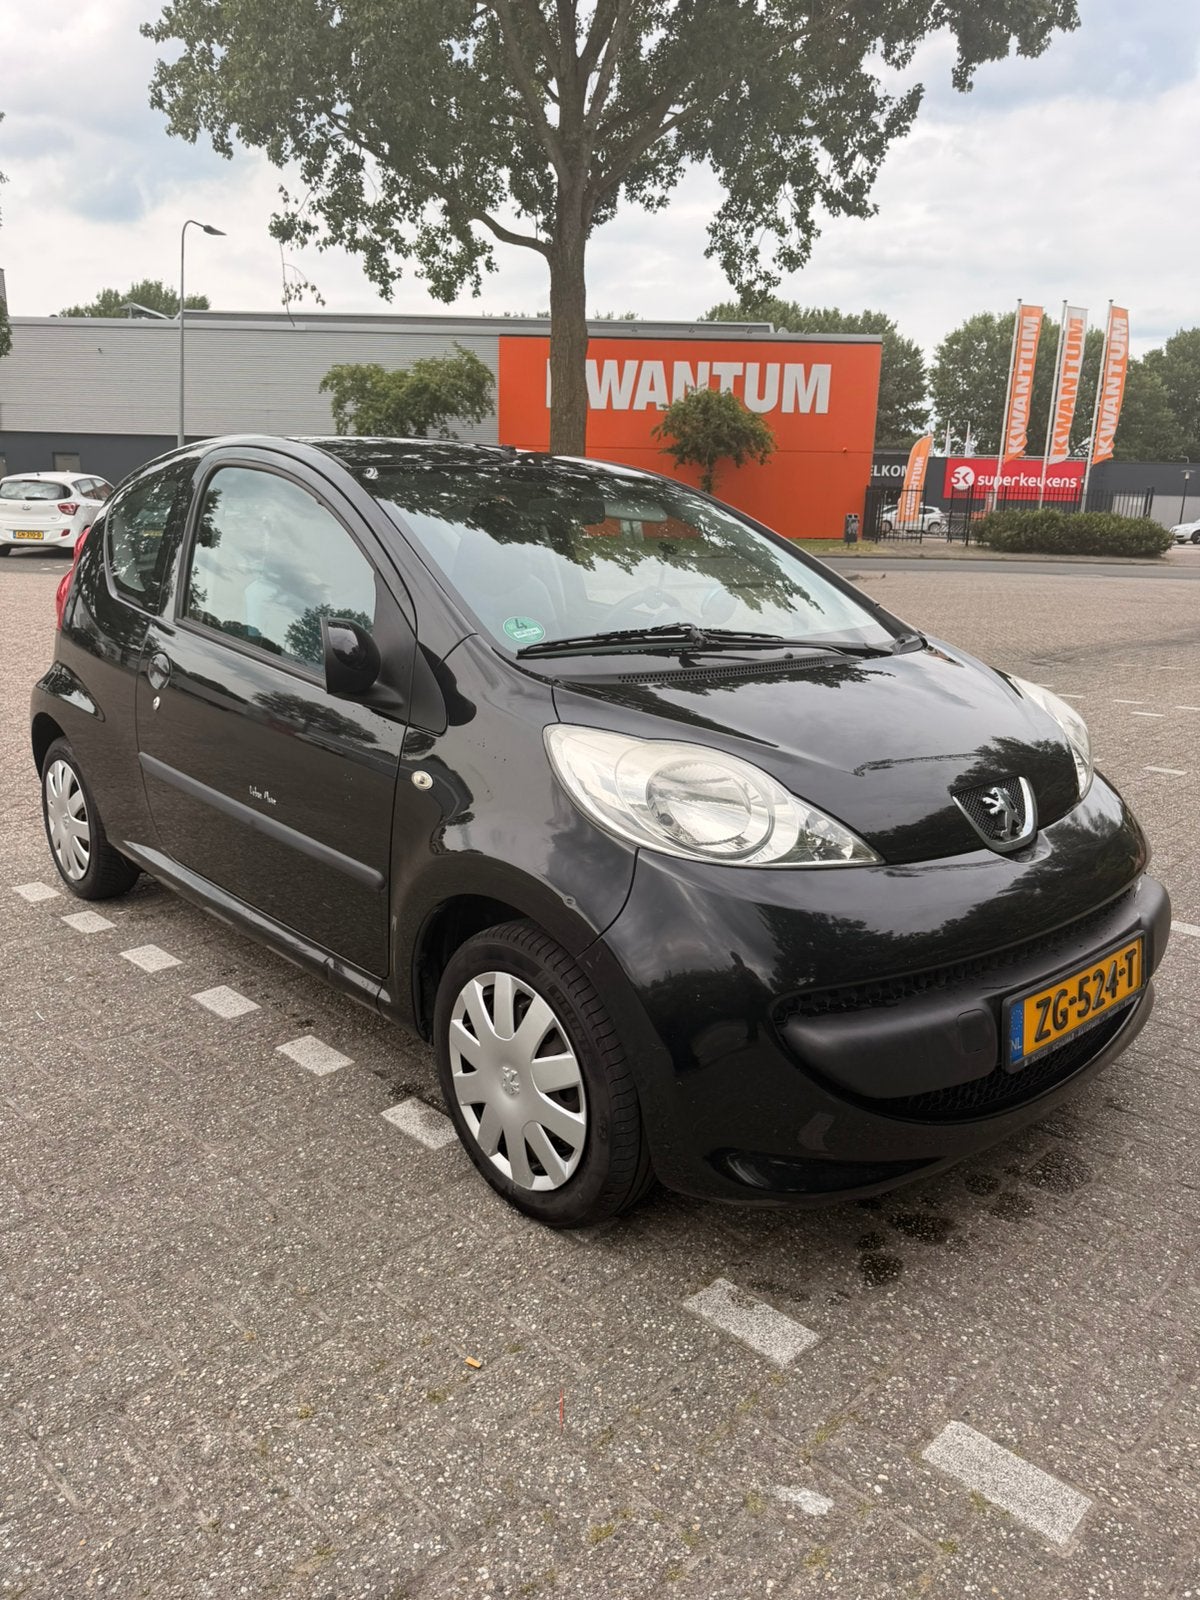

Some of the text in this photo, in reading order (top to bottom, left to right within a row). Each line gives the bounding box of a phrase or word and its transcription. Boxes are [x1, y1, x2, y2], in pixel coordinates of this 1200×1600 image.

[546, 358, 832, 414] WANTUM
[1008, 316, 1040, 454] KWANTUM
[1052, 318, 1084, 456] KWANTUM
[1098, 317, 1128, 455] KWANTUM
[1010, 1039, 1023, 1051] NL
[1034, 947, 1137, 1043] ZG-524-T
